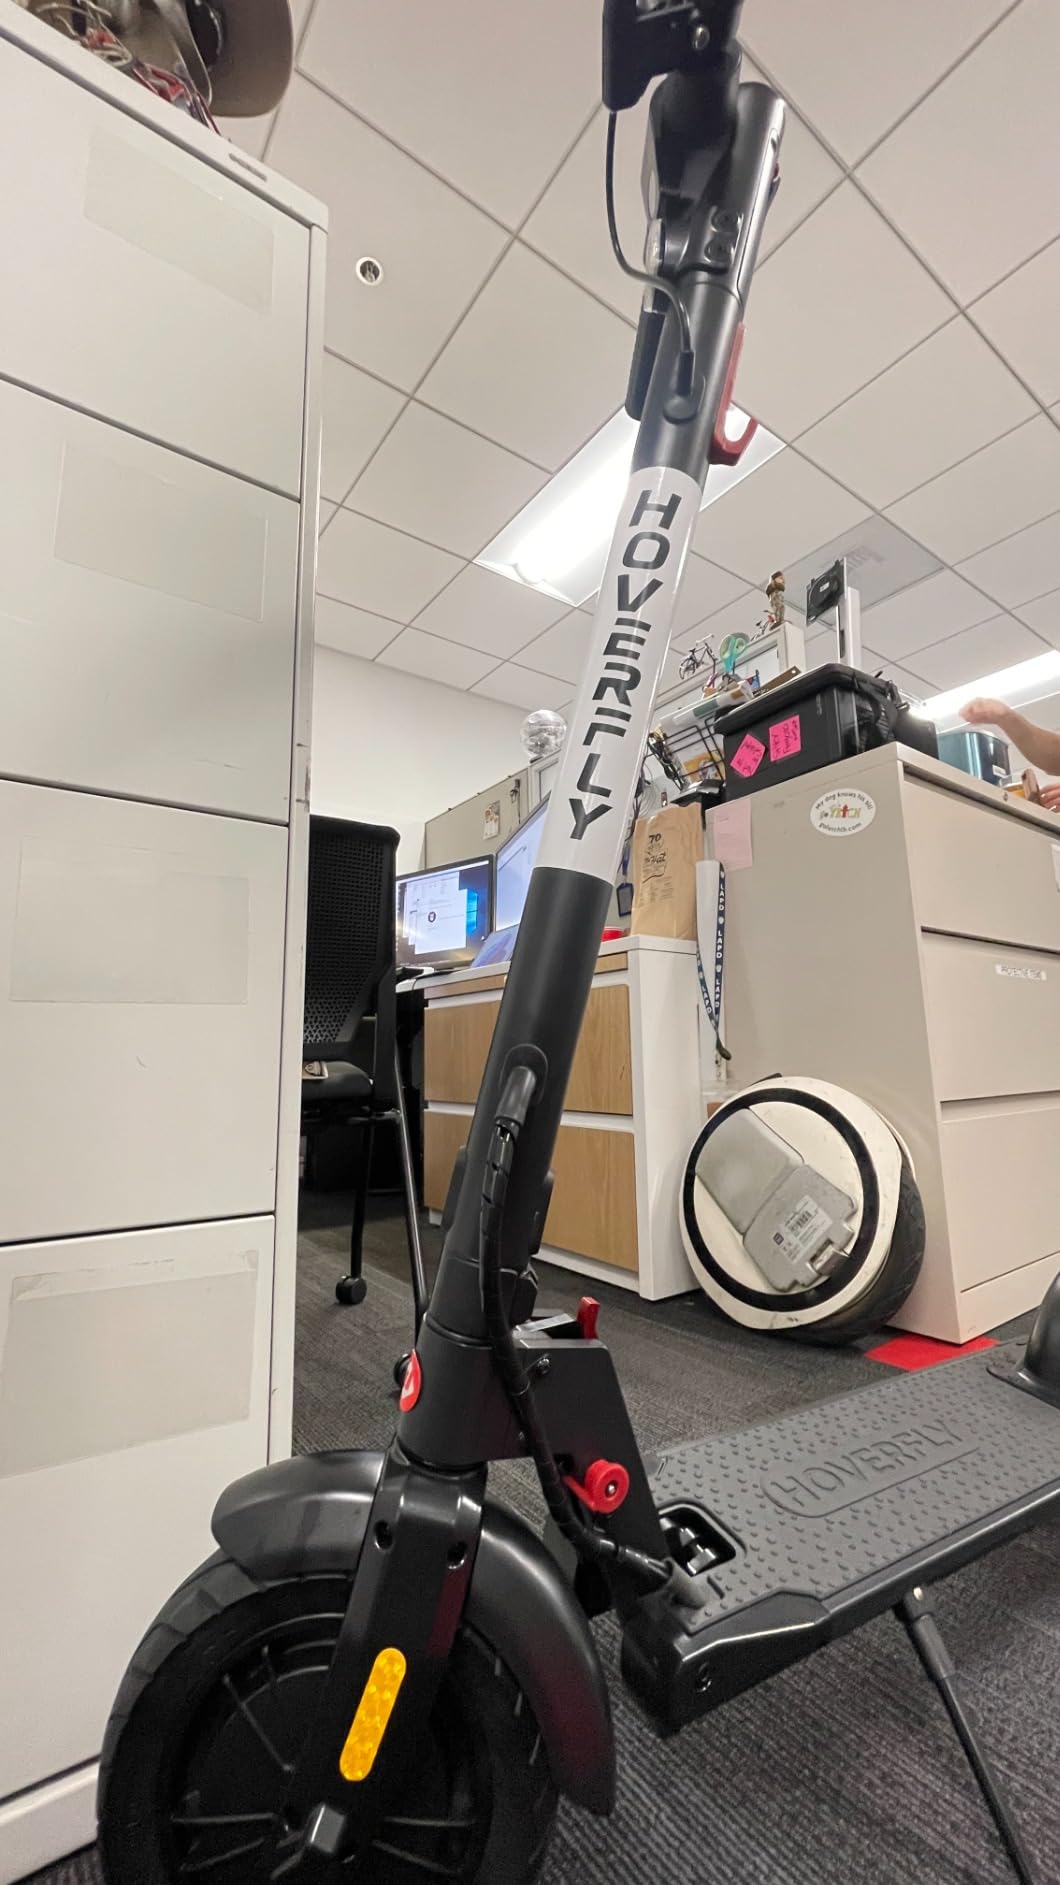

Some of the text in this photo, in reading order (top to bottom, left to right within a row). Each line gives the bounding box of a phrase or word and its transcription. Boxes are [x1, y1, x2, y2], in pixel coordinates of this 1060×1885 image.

[568, 489, 682, 841] HOVERFLY
[701, 985, 712, 1014] LAPD
[770, 1418, 963, 1507] HOVERFLY
